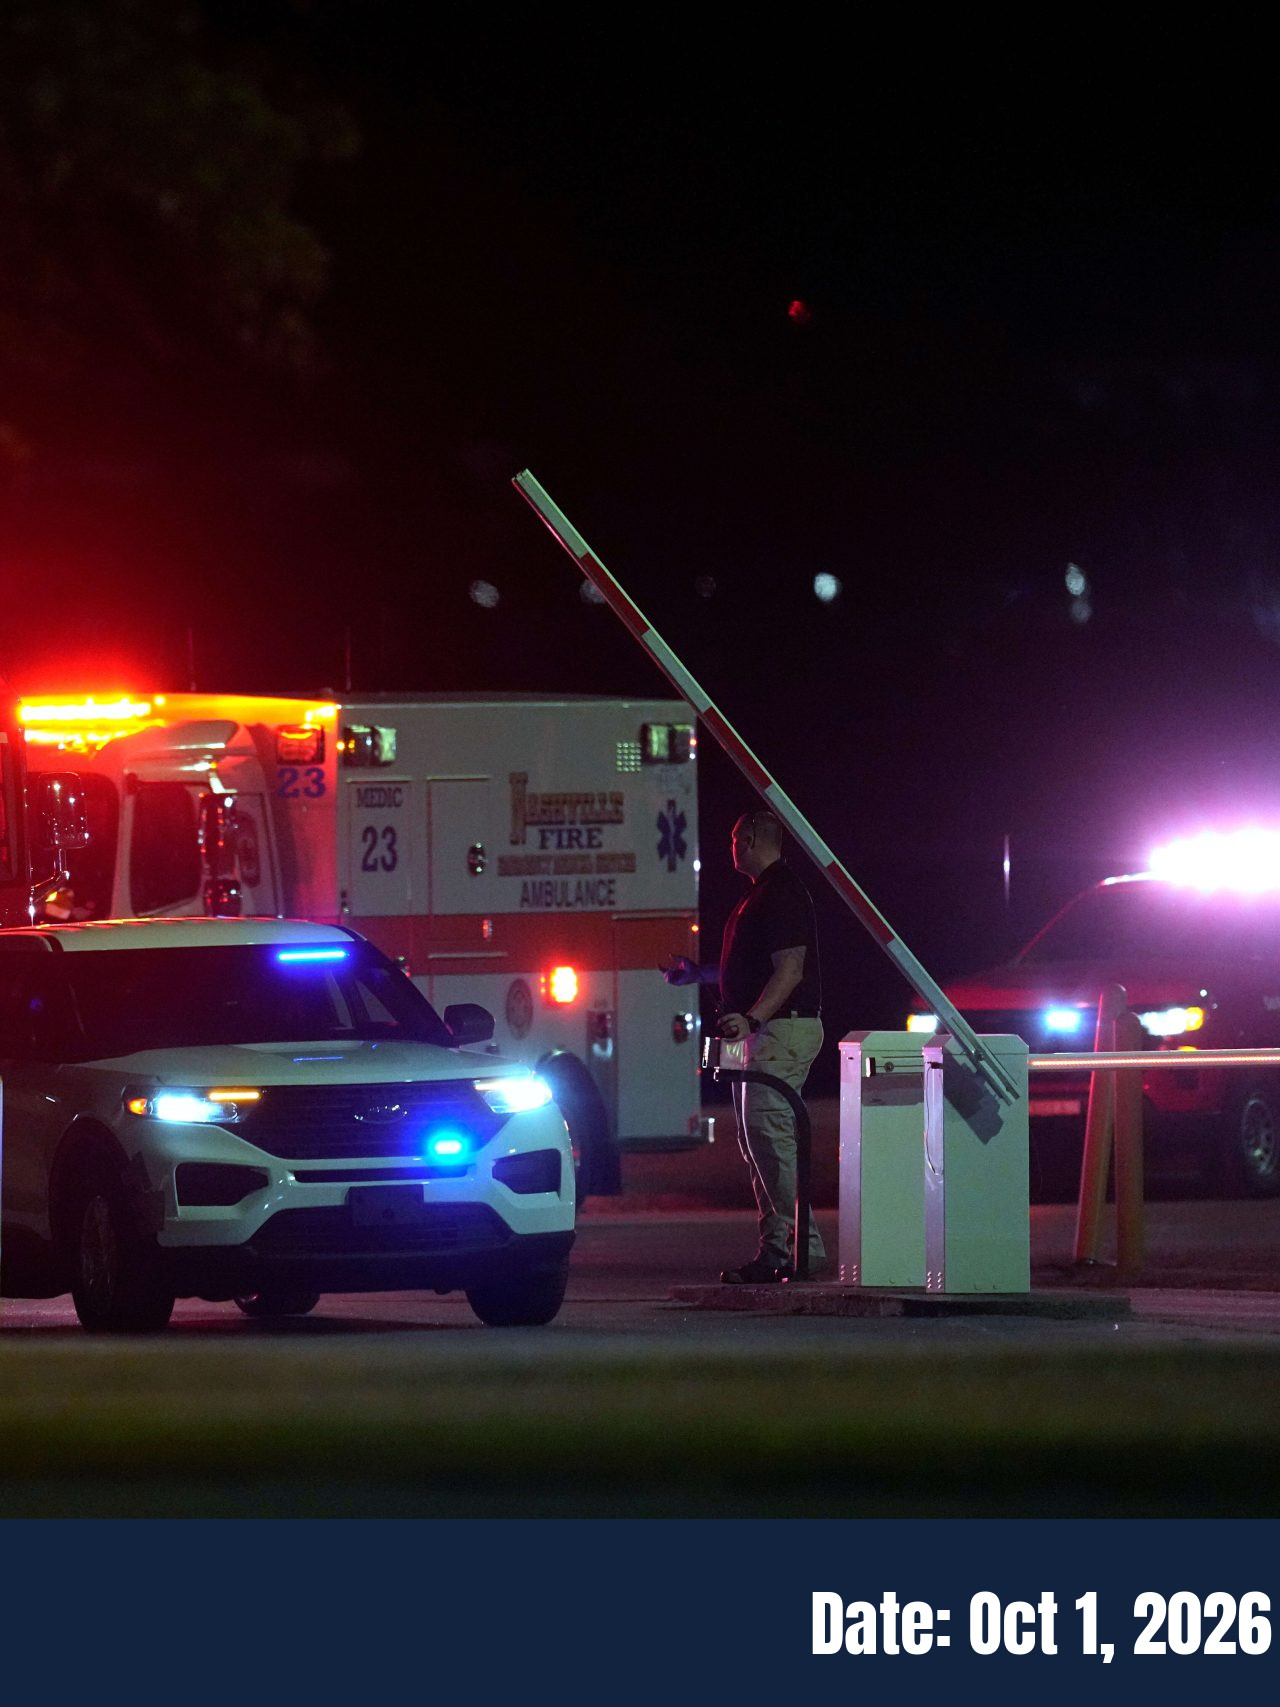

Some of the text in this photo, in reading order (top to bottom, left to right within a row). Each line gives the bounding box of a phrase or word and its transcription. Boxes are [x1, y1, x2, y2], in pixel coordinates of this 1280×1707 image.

[277, 767, 326, 798] 23
[356, 787, 403, 808] MEDIC
[361, 826, 398, 872] 23
[538, 827, 604, 850] FIRE
[520, 878, 616, 908] AMBULANCE
